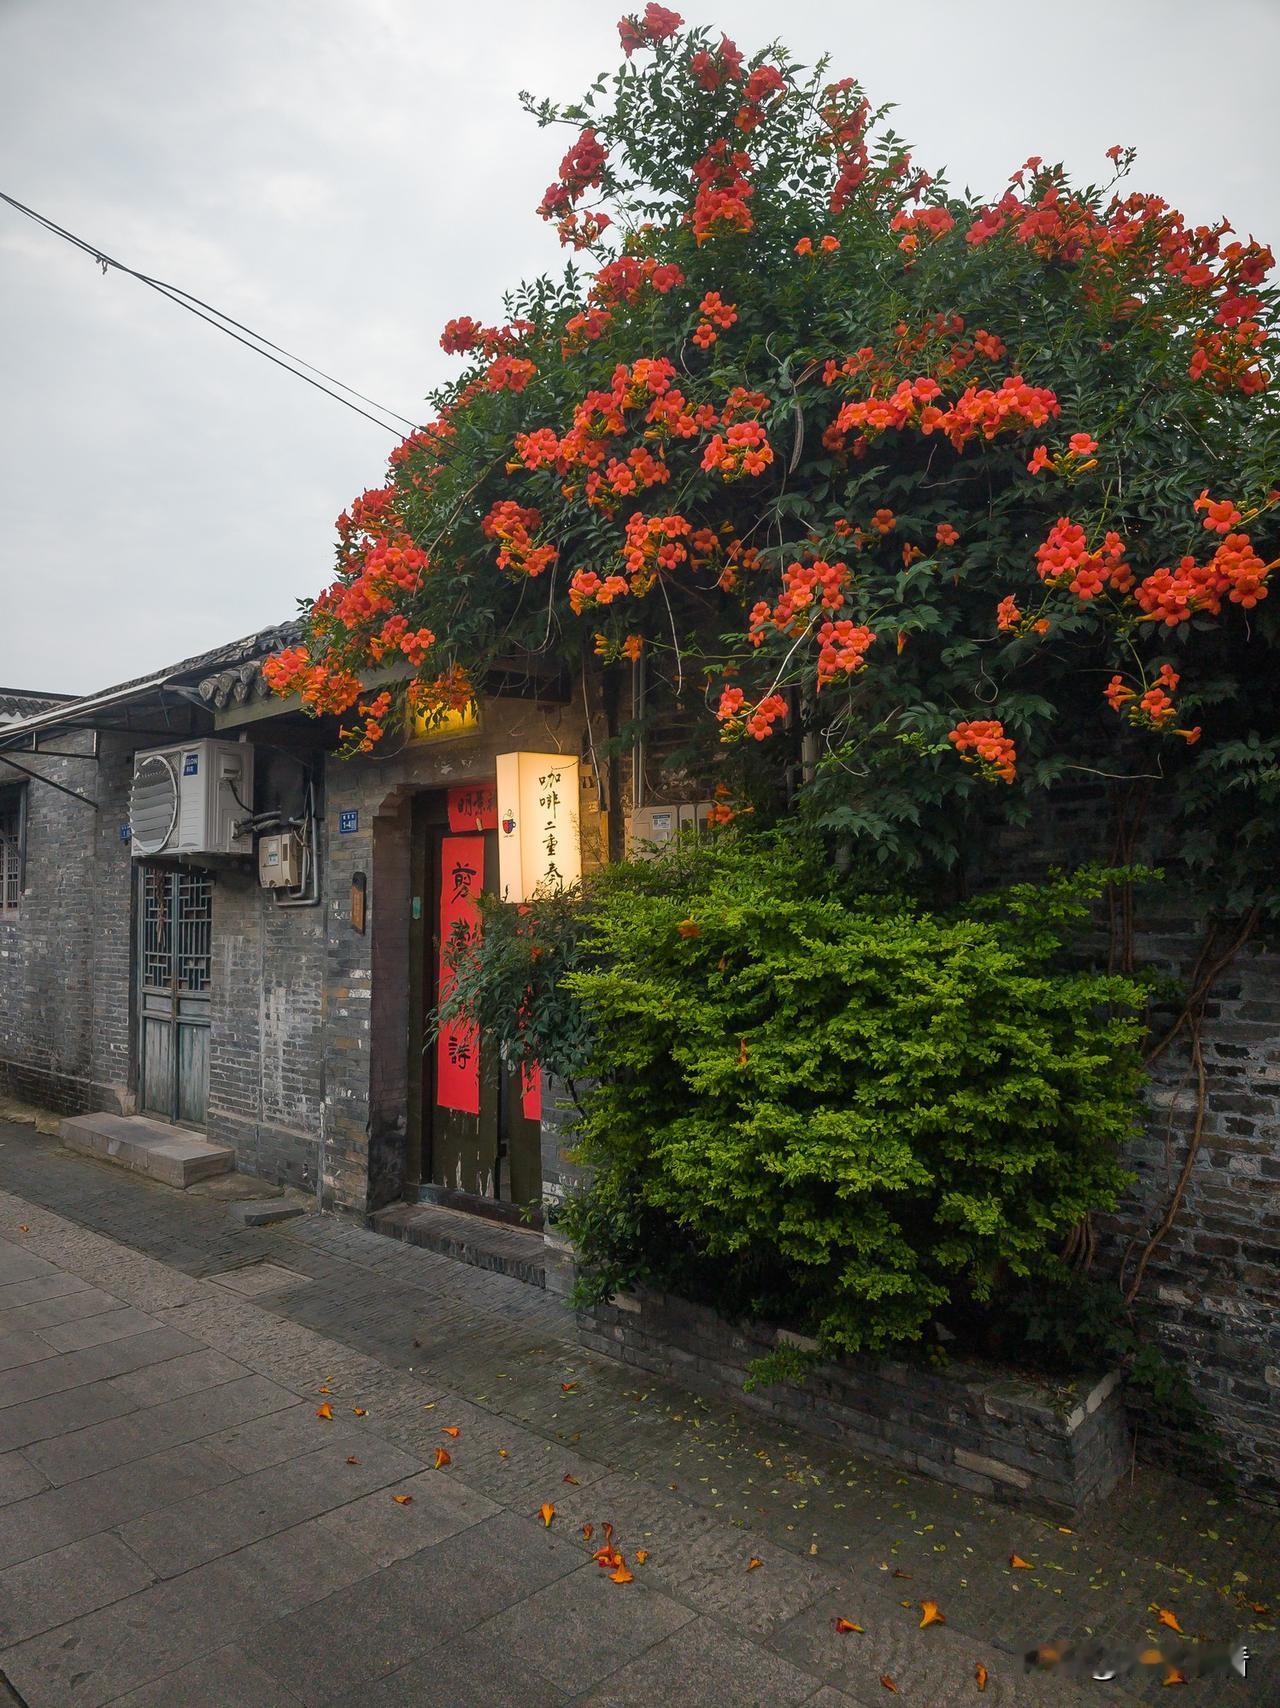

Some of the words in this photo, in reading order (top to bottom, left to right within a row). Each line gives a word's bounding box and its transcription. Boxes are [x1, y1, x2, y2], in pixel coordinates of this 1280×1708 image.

[538, 772, 563, 886] 咖啡二重奏
